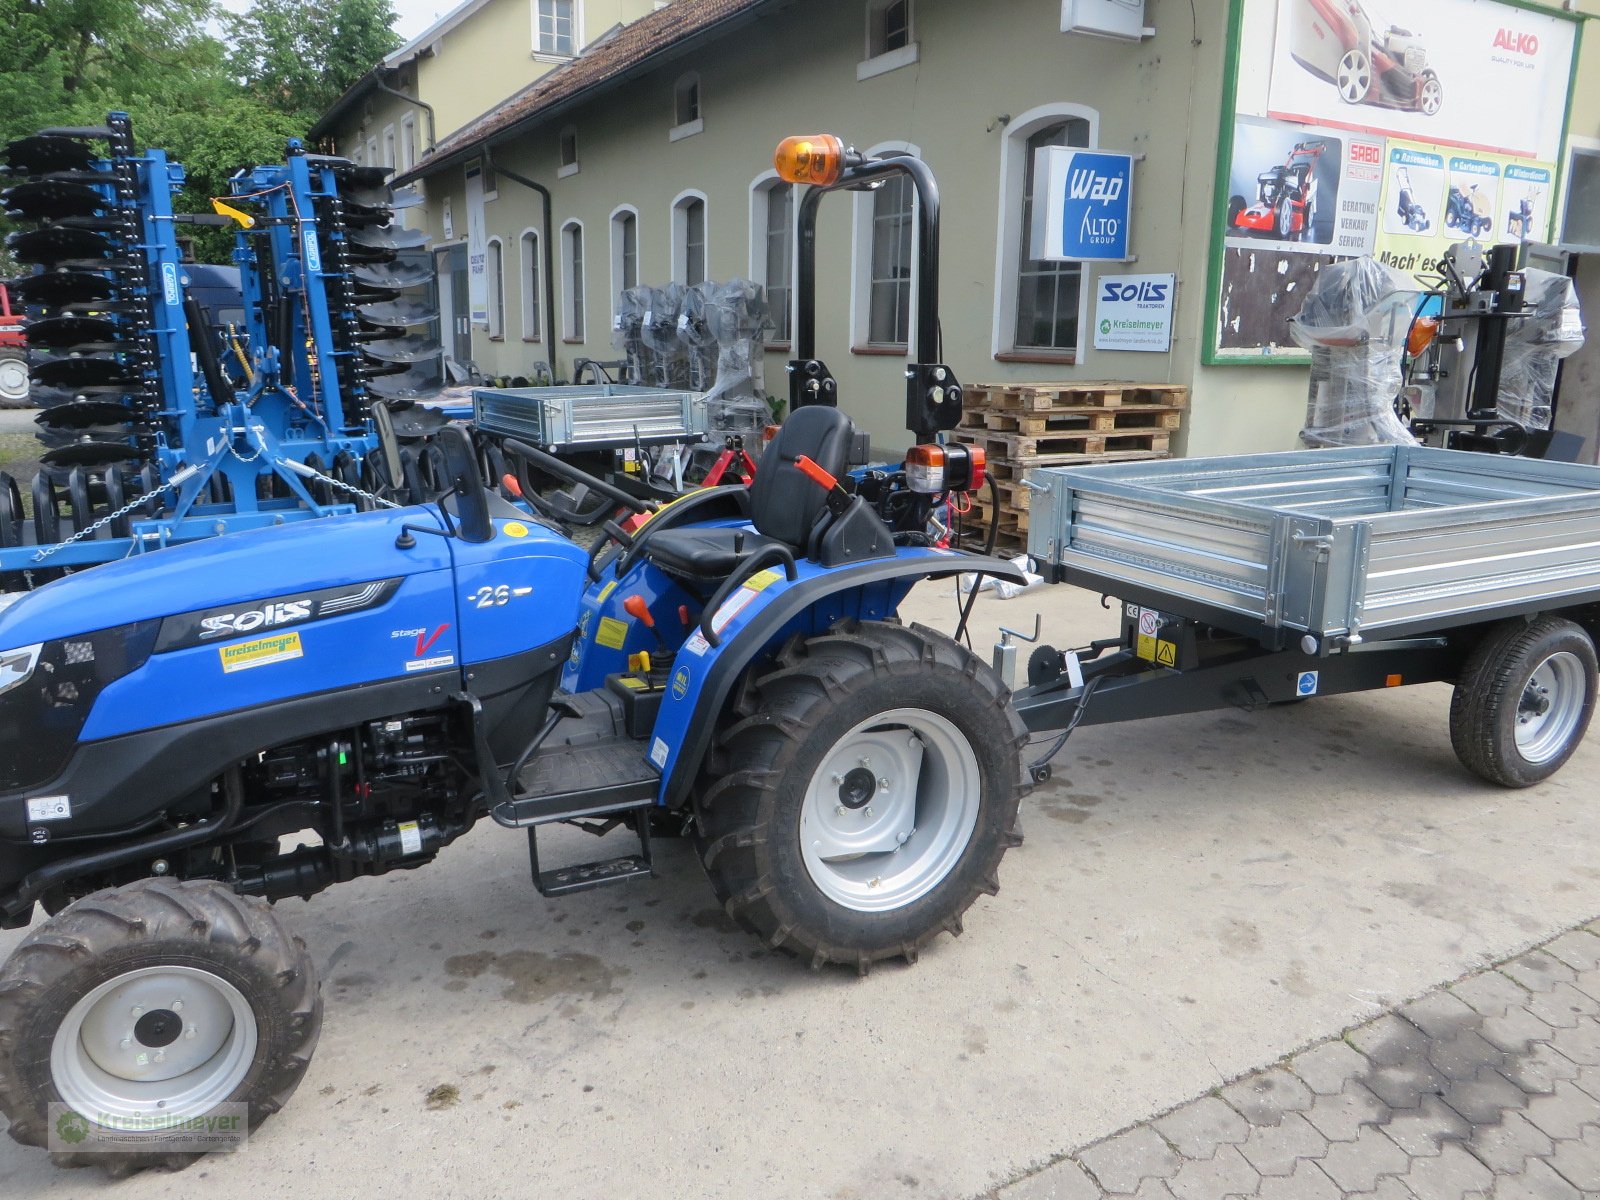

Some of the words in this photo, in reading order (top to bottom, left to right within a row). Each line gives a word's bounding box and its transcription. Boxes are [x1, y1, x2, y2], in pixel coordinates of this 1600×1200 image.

[1493, 28, 1538, 55] AL-KO
[1350, 144, 1380, 164] SABO
[1069, 169, 1123, 206] Wap
[1342, 200, 1375, 215] BERATUNG
[1080, 206, 1117, 243] ALTO
[1341, 218, 1368, 231] VERKAUF
[306, 231, 319, 262] AGRIPOL
[1089, 236, 1115, 244] GROUP
[1338, 235, 1364, 248] SERVICE
[165, 272, 178, 304] AGRIPOL
[1113, 319, 1164, 330] Kreiselmeyer
[477, 585, 510, 608] 26
[391, 627, 427, 638] Stage
[414, 623, 451, 657] V
[224, 635, 297, 658] kreiselmeyer
